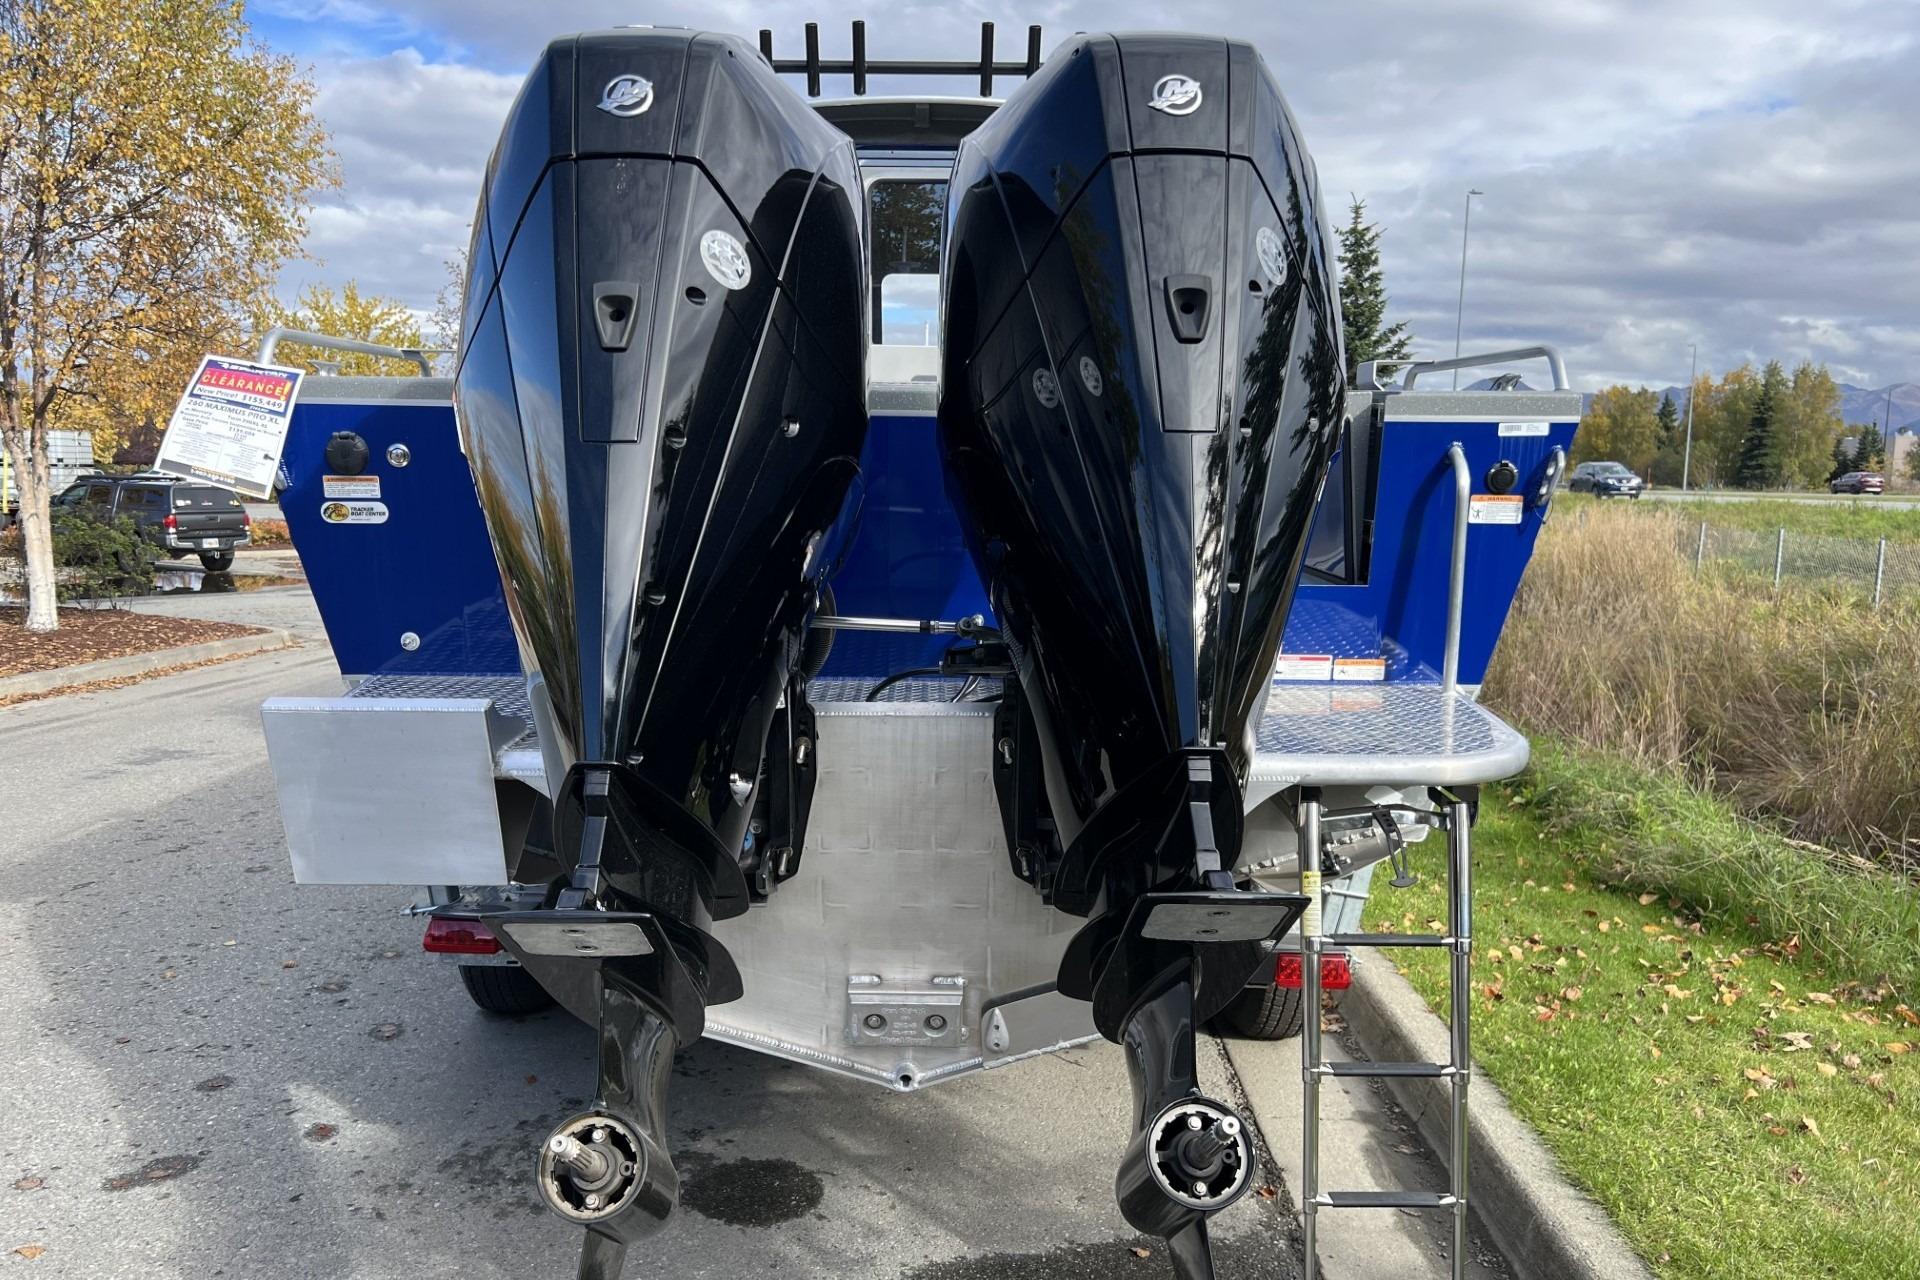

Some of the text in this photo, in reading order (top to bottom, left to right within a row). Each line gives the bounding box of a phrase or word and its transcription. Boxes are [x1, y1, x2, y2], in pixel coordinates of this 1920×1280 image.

[197, 387, 215, 395] New
[202, 374, 293, 401] CLEARANCE!
[205, 402, 246, 417] MAXIMUS
[247, 412, 267, 421] PRO
[268, 417, 280, 425] XL
